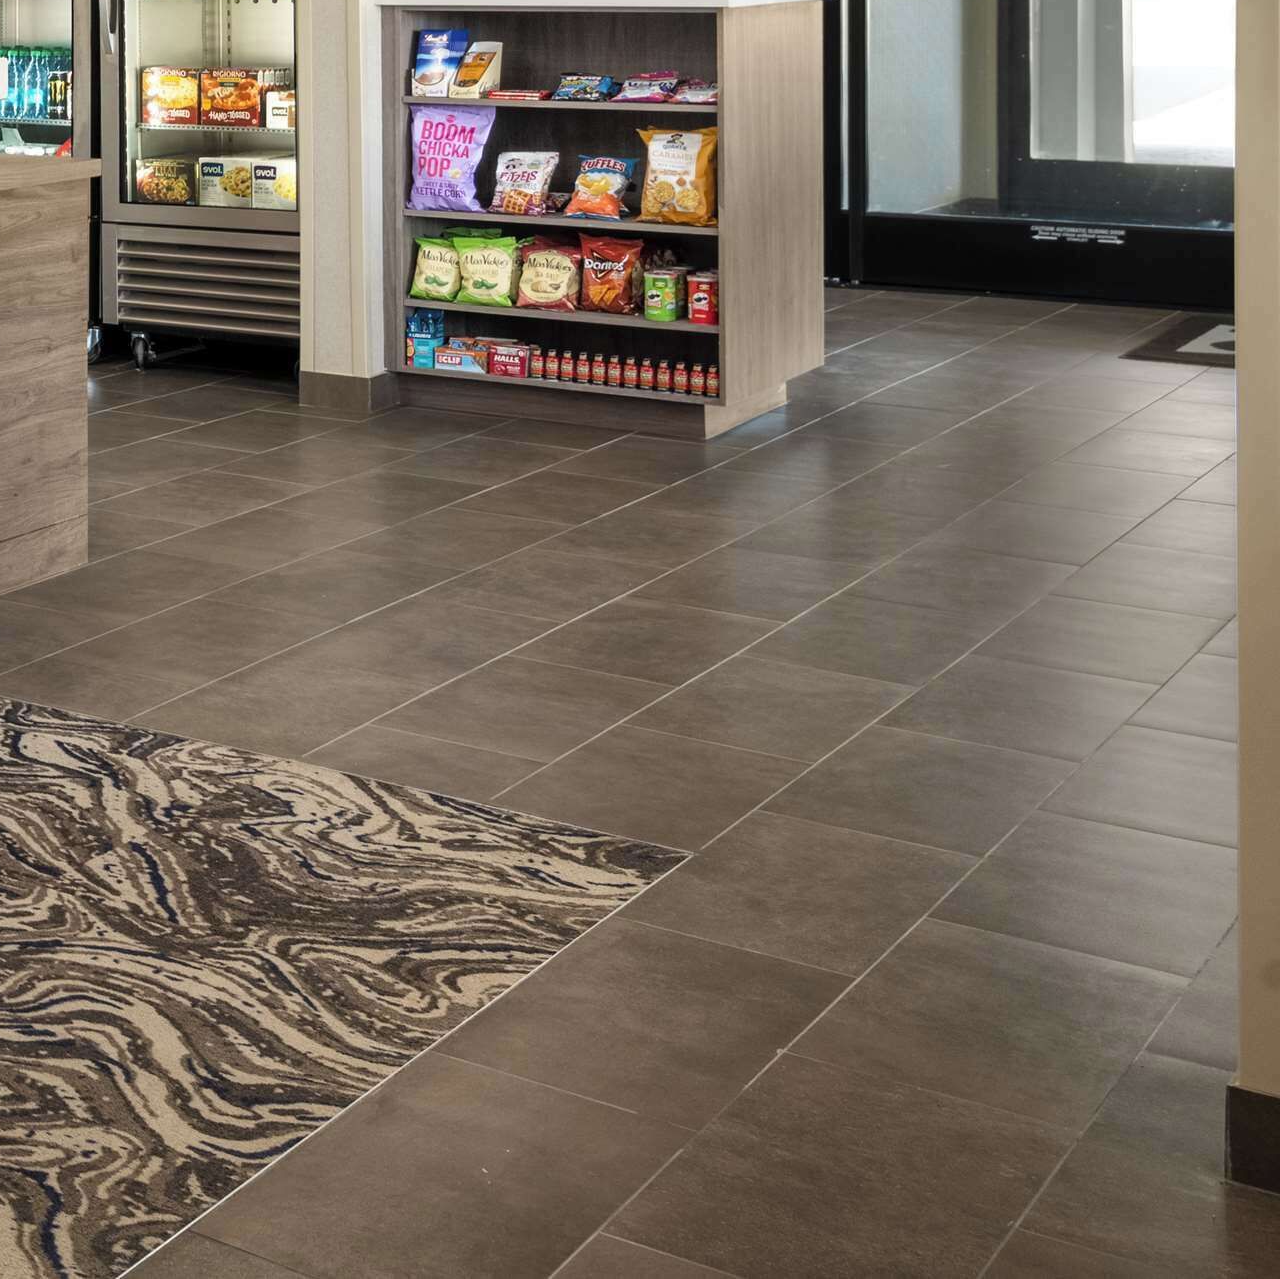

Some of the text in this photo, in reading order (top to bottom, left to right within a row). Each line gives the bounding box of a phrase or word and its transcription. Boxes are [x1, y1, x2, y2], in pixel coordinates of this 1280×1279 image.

[421, 120, 476, 144] BOOM
[418, 140, 470, 158] CHICKA
[418, 156, 452, 178] POP
[415, 187, 442, 197] KETTLE
[584, 258, 625, 272] Doritos
